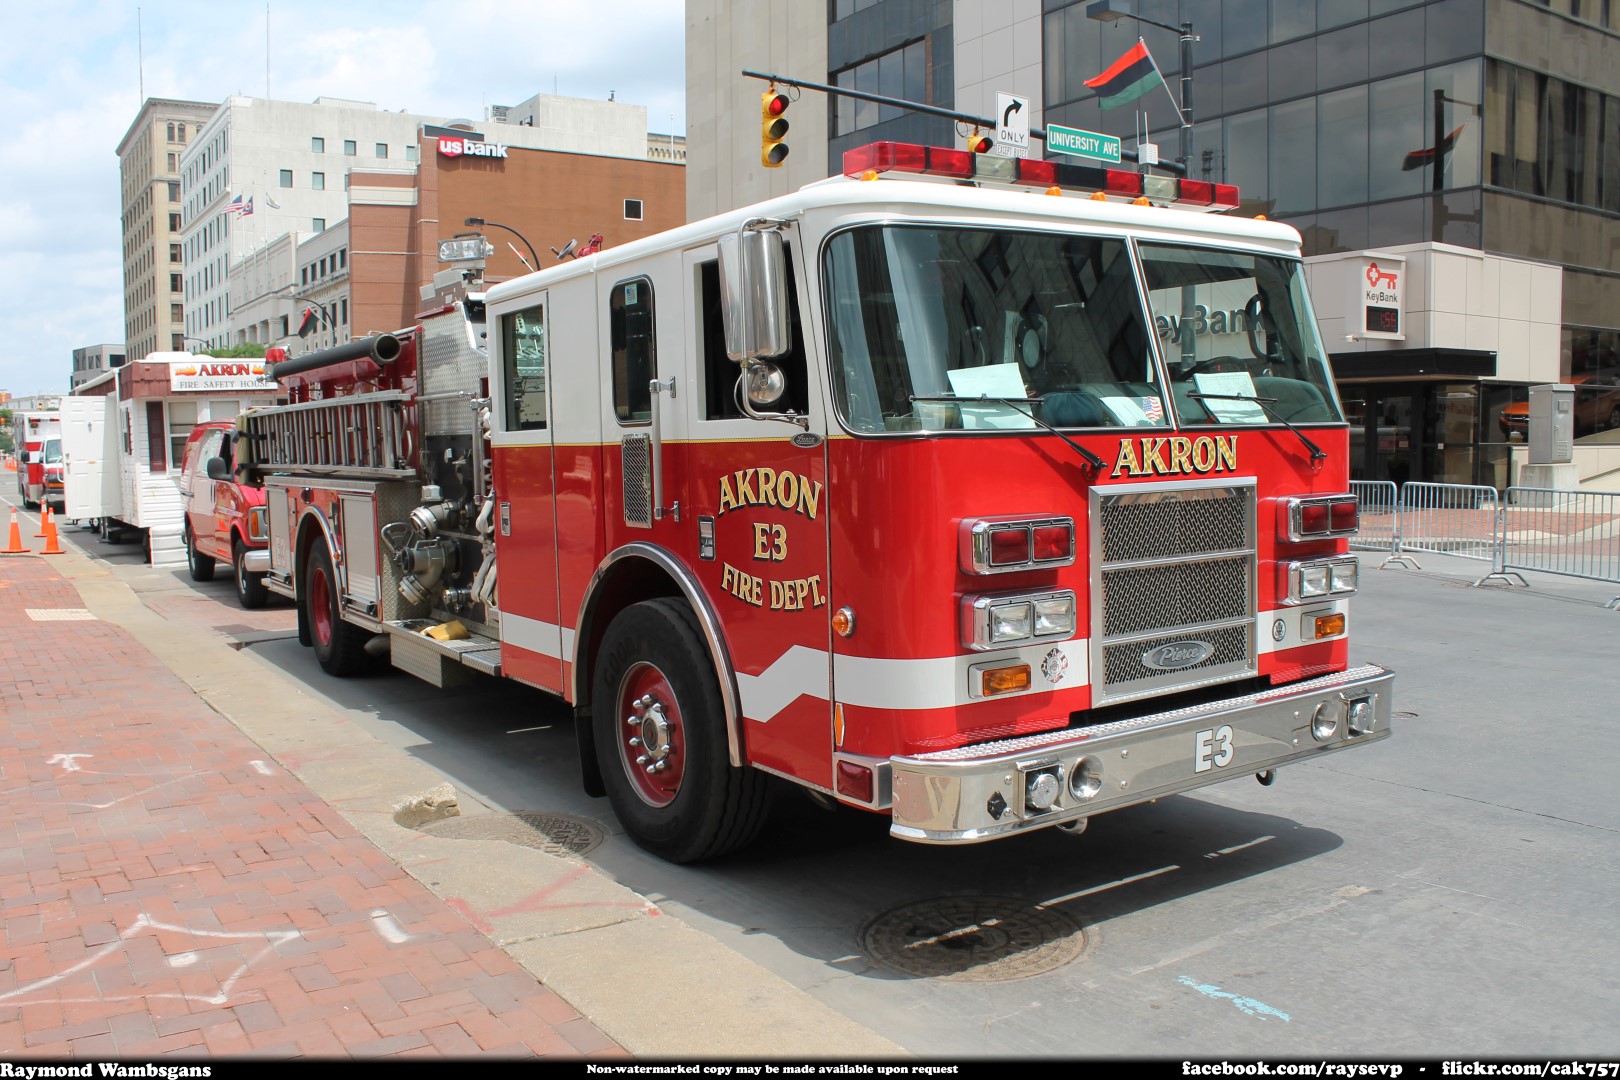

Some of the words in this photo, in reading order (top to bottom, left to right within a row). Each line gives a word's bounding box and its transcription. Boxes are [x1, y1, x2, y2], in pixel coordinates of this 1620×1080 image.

[1001, 129, 1025, 143] ONLY
[1050, 131, 1100, 153] UNIVERSITY
[1103, 142, 1119, 157] AVE
[1366, 291, 1398, 303] KeyBank
[199, 363, 251, 377] AKRON
[180, 381, 199, 389] FIRE
[204, 380, 235, 389] SAFETY
[240, 380, 269, 388] HOUSE
[1110, 435, 1239, 477] AKRON
[718, 467, 823, 520] AKRON
[753, 522, 788, 562] E3
[721, 562, 763, 607] FIRE
[770, 574, 826, 611] DEPT.
[1159, 645, 1200, 667] Pierce
[1194, 724, 1235, 774] E3
